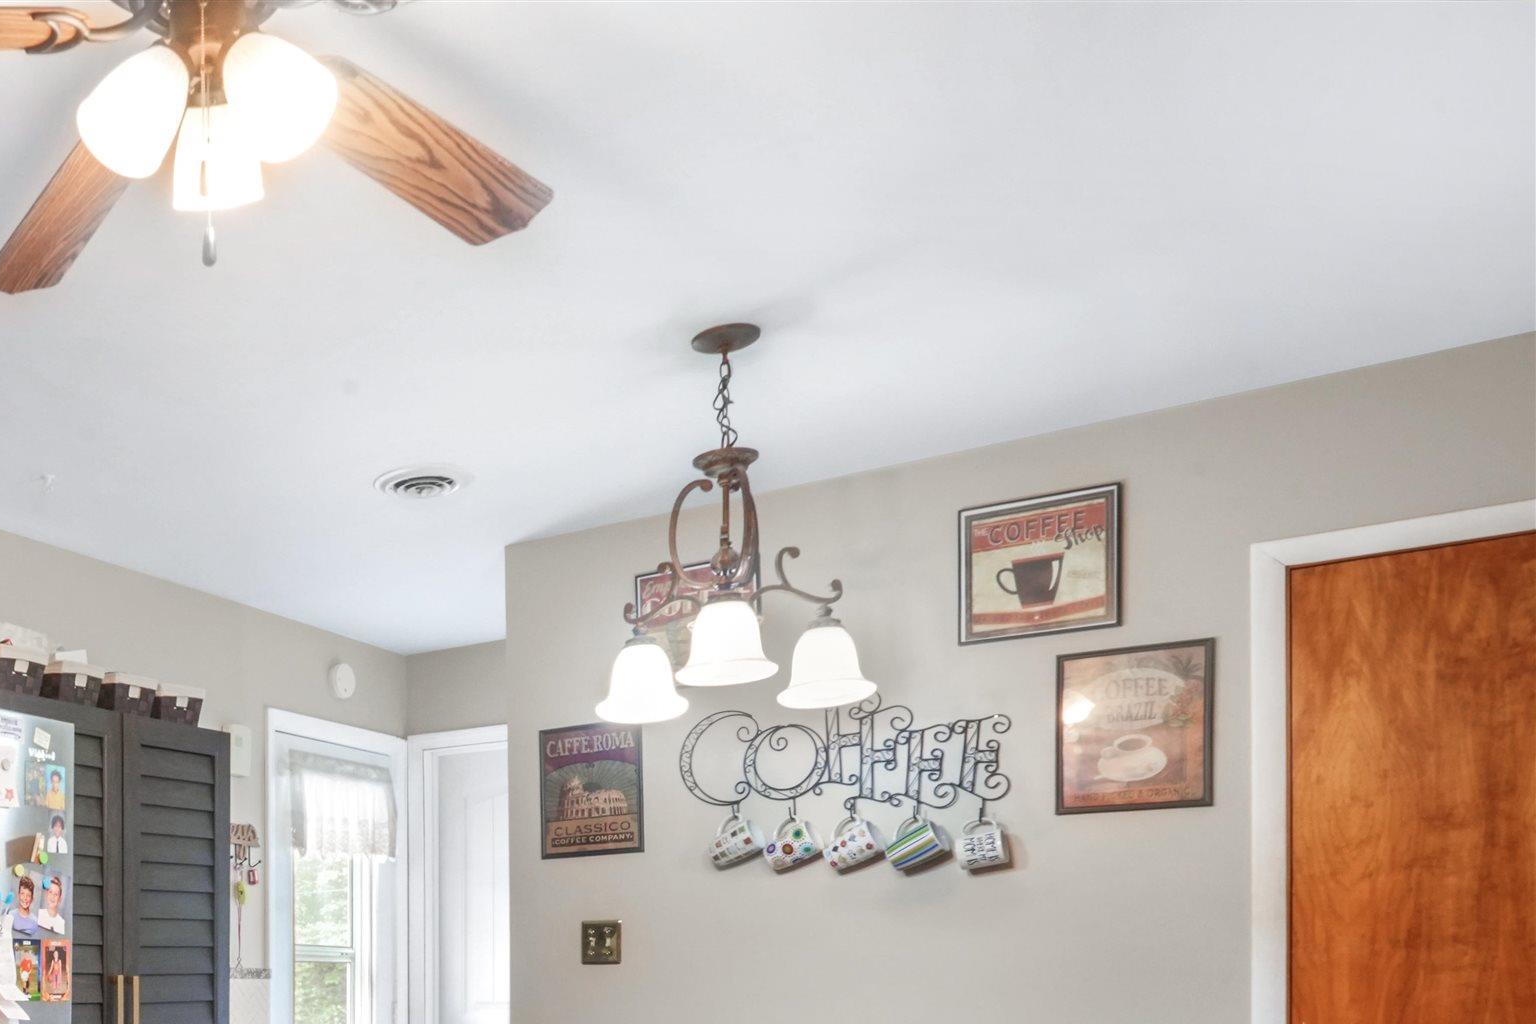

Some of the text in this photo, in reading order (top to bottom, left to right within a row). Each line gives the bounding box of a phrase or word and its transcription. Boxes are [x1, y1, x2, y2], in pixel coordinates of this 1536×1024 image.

[988, 511, 1085, 546] COFFEE
[1054, 523, 1105, 551] Shop
[1105, 677, 1171, 699] OFFEE
[593, 730, 635, 752] ROMA
[679, 692, 1012, 809] COFFEE
[554, 821, 631, 837] CLASSICO
[555, 833, 631, 845] COFFEE COMPANY
